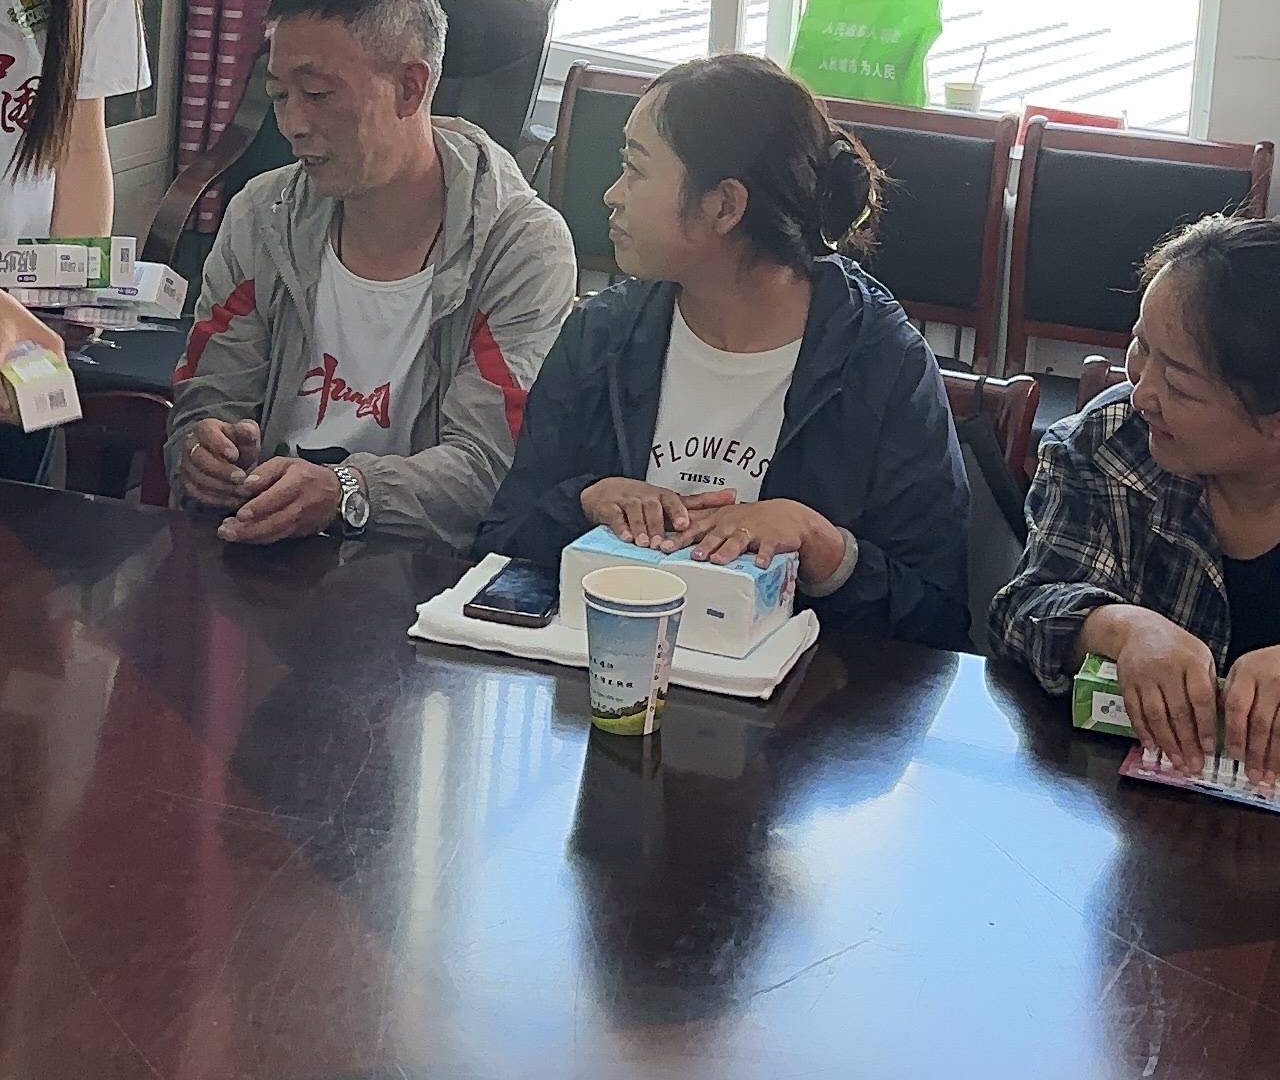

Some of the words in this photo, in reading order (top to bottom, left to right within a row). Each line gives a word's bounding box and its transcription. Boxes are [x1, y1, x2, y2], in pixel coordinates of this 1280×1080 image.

[651, 436, 770, 478] FLOWERS
[679, 472, 711, 484] THIS
[712, 475, 726, 486] IS
